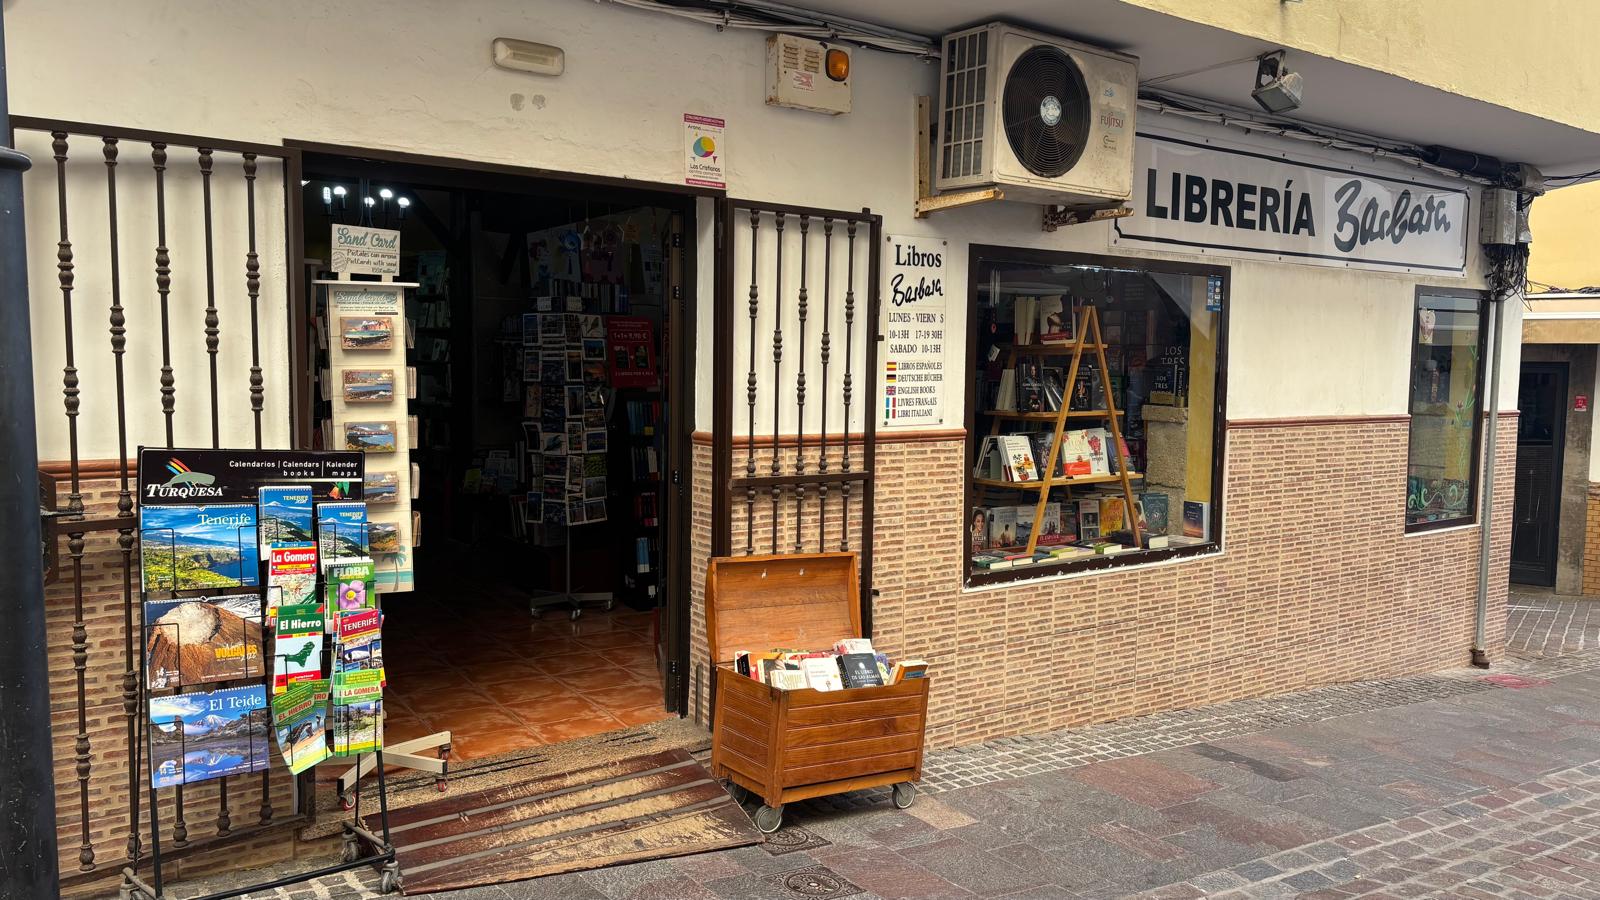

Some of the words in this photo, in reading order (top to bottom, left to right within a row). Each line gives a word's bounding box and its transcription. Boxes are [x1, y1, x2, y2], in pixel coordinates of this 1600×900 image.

[1101, 115, 1124, 128] FUJITSU
[1146, 168, 1316, 237] LIBRERÍA
[338, 228, 368, 246] Sand
[370, 233, 398, 248] Card
[895, 244, 942, 268] Libros
[888, 312, 911, 323] LUNES
[889, 330, 909, 339] 10-13H
[890, 344, 917, 353] SABADO
[922, 344, 941, 353] 10-13H
[1165, 346, 1182, 355] LOS
[898, 362, 915, 370] LIBROS
[916, 361, 942, 370] ESPAÑOLES
[146, 484, 223, 498] TURQUESA
[198, 513, 251, 525] Tenerife
[272, 552, 282, 562] La
[284, 551, 315, 562] Gomera
[280, 620, 289, 630] El
[291, 619, 321, 629] Hierro
[344, 618, 378, 631] TENERIFE
[354, 687, 380, 695] GOMERA
[210, 699, 223, 711] El
[227, 695, 262, 708] Teide
[288, 700, 312, 716] HIERRO
